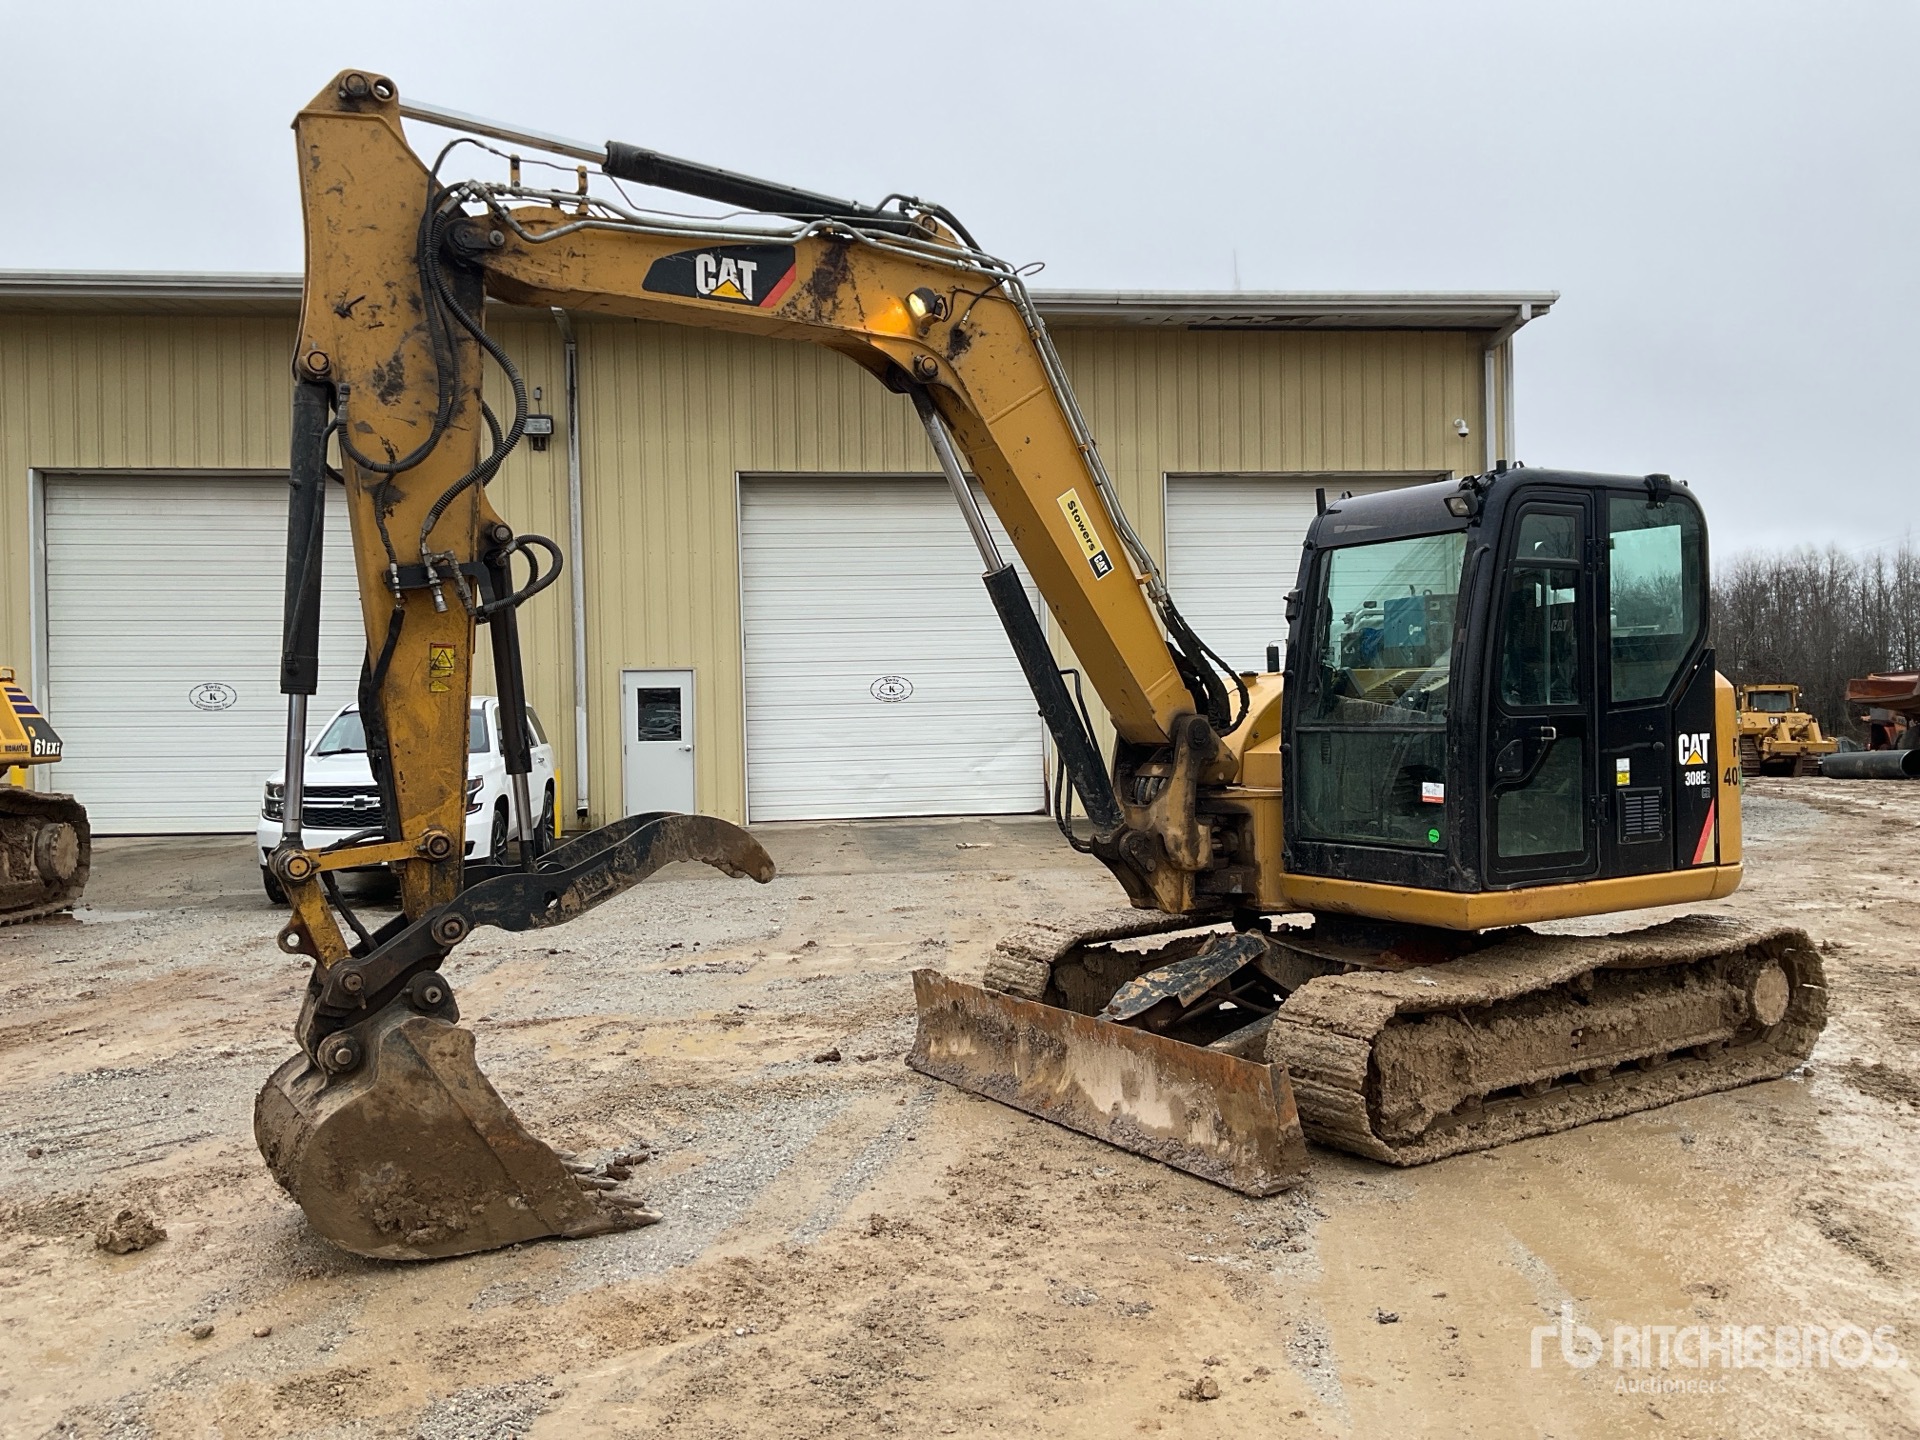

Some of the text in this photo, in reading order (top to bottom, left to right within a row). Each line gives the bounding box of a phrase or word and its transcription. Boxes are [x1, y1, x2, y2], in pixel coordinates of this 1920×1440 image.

[695, 253, 757, 301] CAT
[1067, 500, 1096, 551] Stowers
[1093, 554, 1109, 573] CAT
[209, 692, 217, 701] K
[889, 685, 896, 693] K
[33, 738, 60, 756] 61EXi
[1678, 733, 1710, 765] CAT
